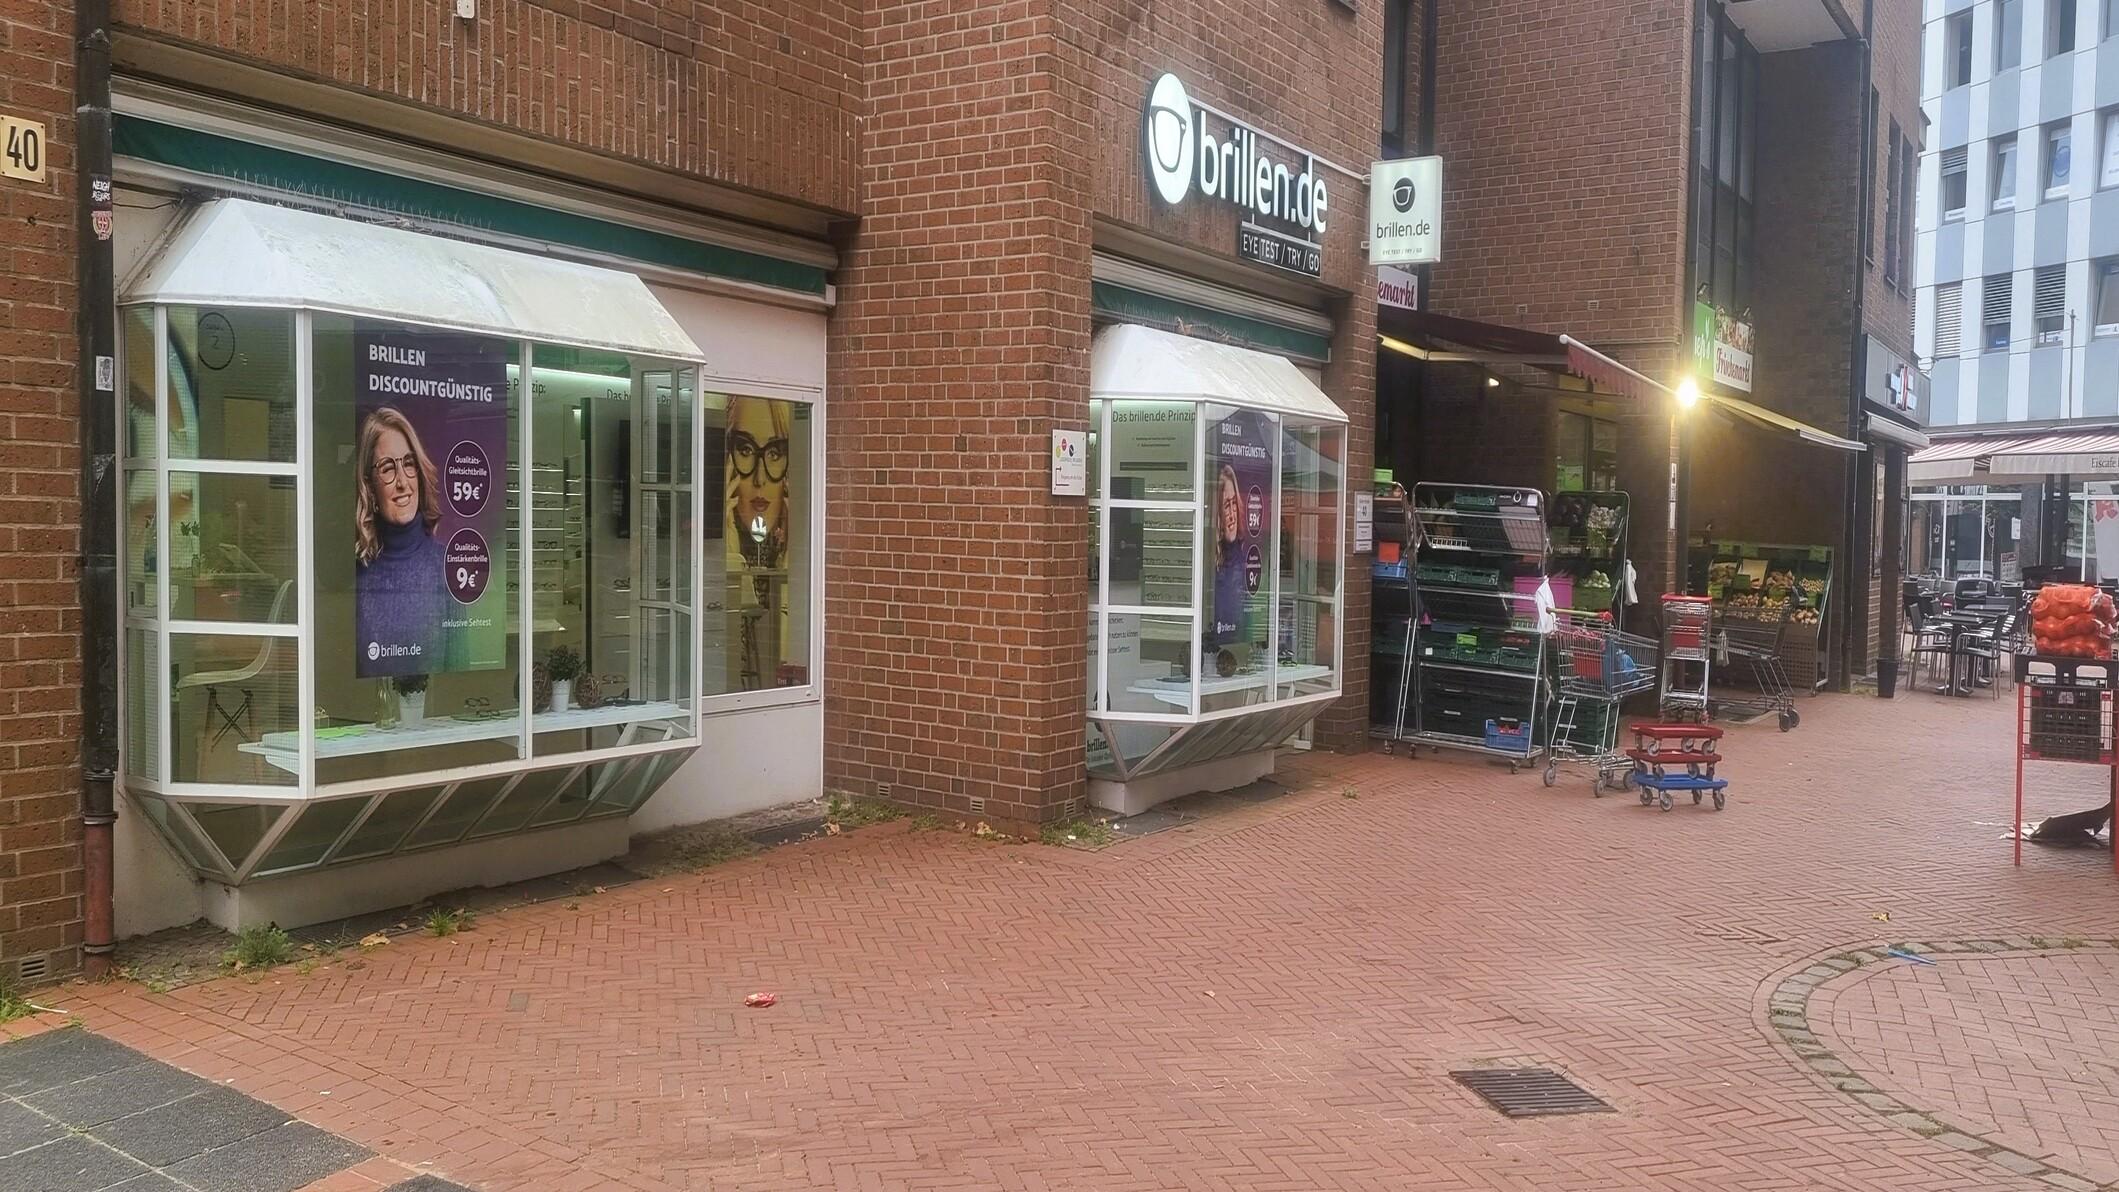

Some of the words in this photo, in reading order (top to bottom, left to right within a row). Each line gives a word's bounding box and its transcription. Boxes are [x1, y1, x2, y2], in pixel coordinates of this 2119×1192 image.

[7, 125, 39, 172] 40
[1200, 110, 1328, 234] brillen.de
[1377, 219, 1431, 238] brillen.de
[1243, 233, 1259, 255] EYE
[1260, 238, 1280, 260] TEST
[1287, 246, 1301, 267] TRY
[1308, 252, 1320, 272] GO
[368, 344, 426, 367] BRILLEN
[368, 373, 493, 402] DISCOUNTGÜNSTIG
[1112, 410, 1128, 422] Das
[1129, 409, 1166, 422] brillen.de
[1221, 422, 1242, 437] BRILLEN
[1221, 442, 1266, 460] DISCOUNTGÜNSTIG
[454, 455, 481, 465] Qualitäts-
[448, 466, 488, 477] Gleitsichtbrille
[454, 543, 481, 552] Qualitäts-
[447, 554, 488, 563] Einstärkenbrille
[442, 618, 468, 628] inklusive
[468, 618, 492, 627] Sehtest
[380, 642, 422, 658] brillen.de
